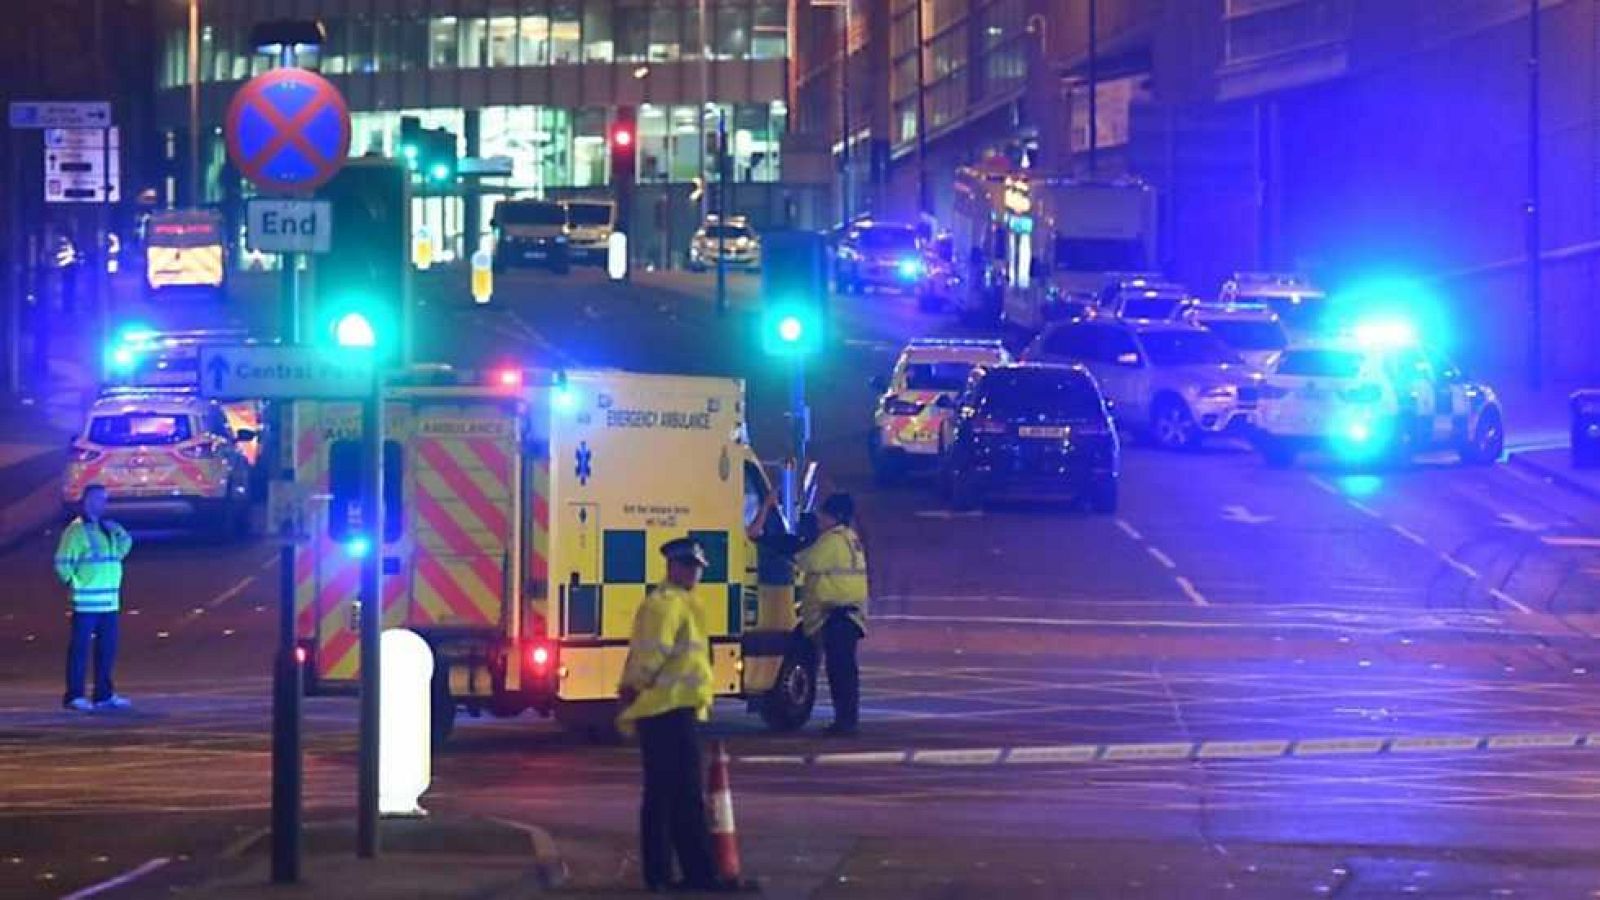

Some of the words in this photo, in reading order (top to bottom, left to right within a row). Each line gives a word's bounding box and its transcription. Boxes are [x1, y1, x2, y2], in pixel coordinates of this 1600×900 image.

[262, 211, 316, 235] End
[236, 361, 313, 379] Central
[320, 361, 366, 379] Pa
[423, 422, 504, 433] AMBULANCE
[607, 409, 657, 427] EMERGENCY
[661, 411, 710, 429] AMBULANCE
